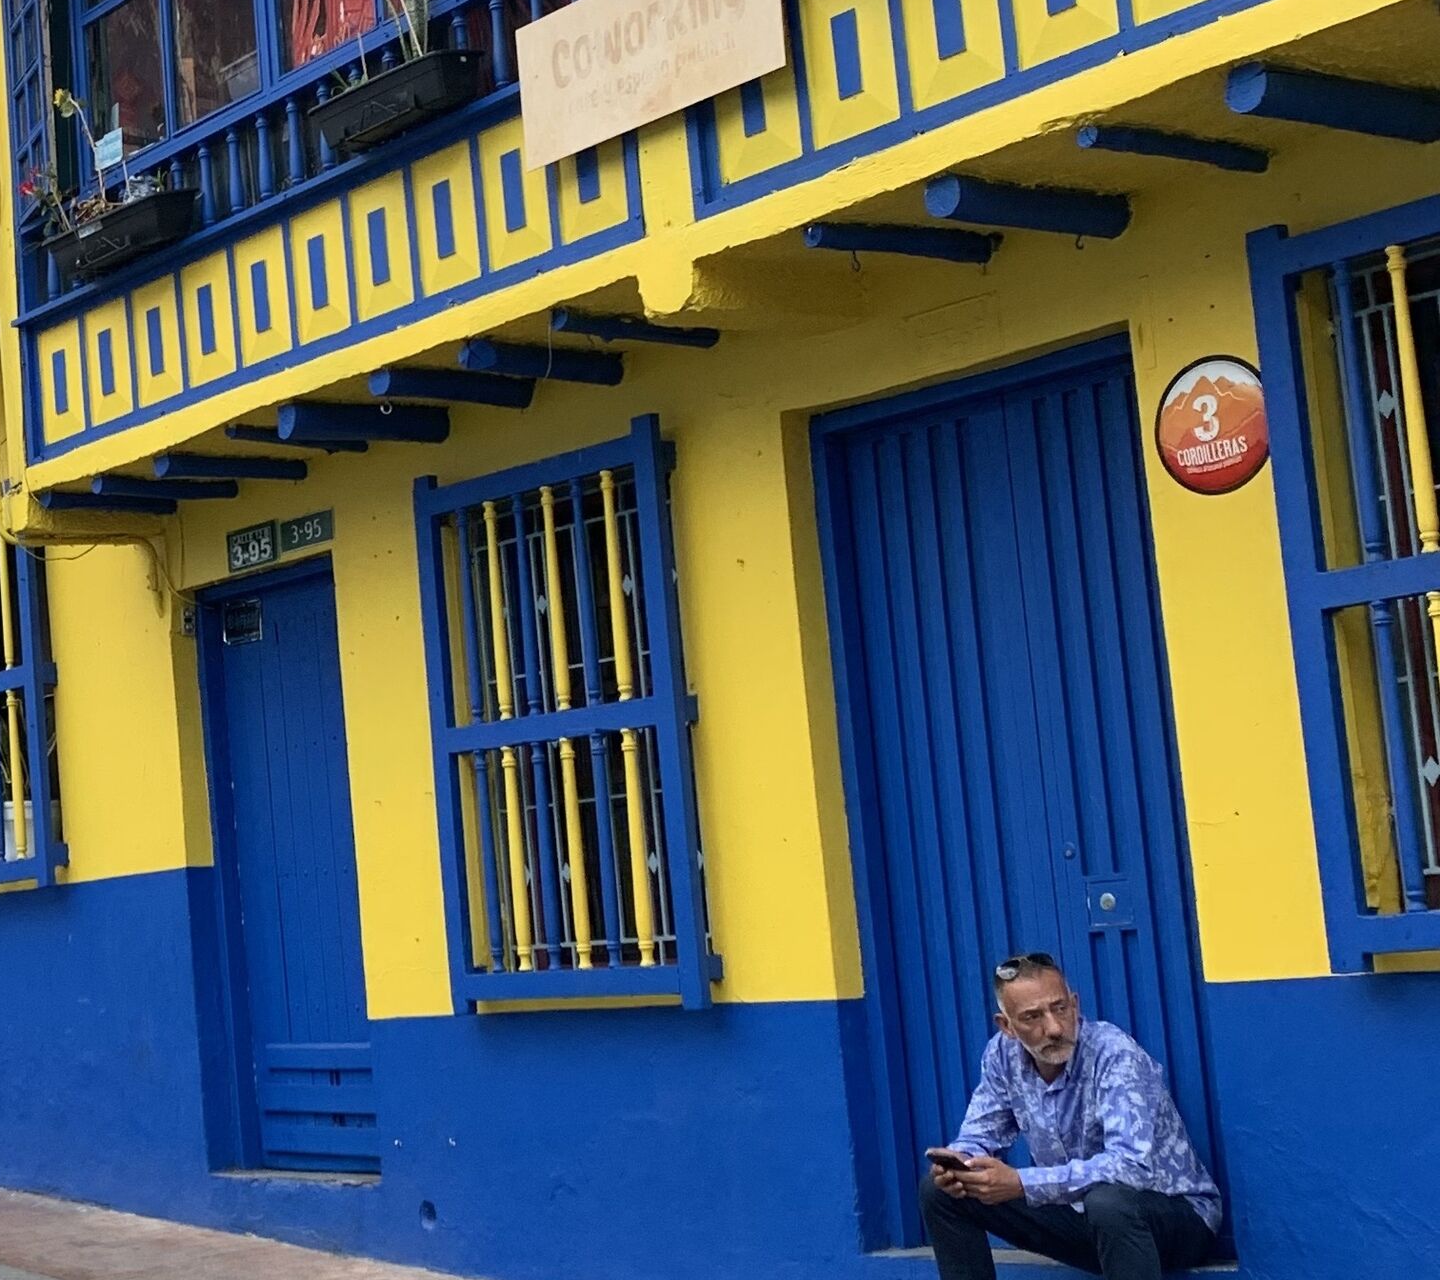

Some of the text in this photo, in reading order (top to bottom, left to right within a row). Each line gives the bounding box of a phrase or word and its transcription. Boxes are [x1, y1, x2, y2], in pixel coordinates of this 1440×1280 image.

[1192, 394, 1220, 442] 3
[1177, 435, 1249, 468] CORDILLERAS
[291, 519, 322, 544] 3-95
[233, 538, 272, 566] 3-95
